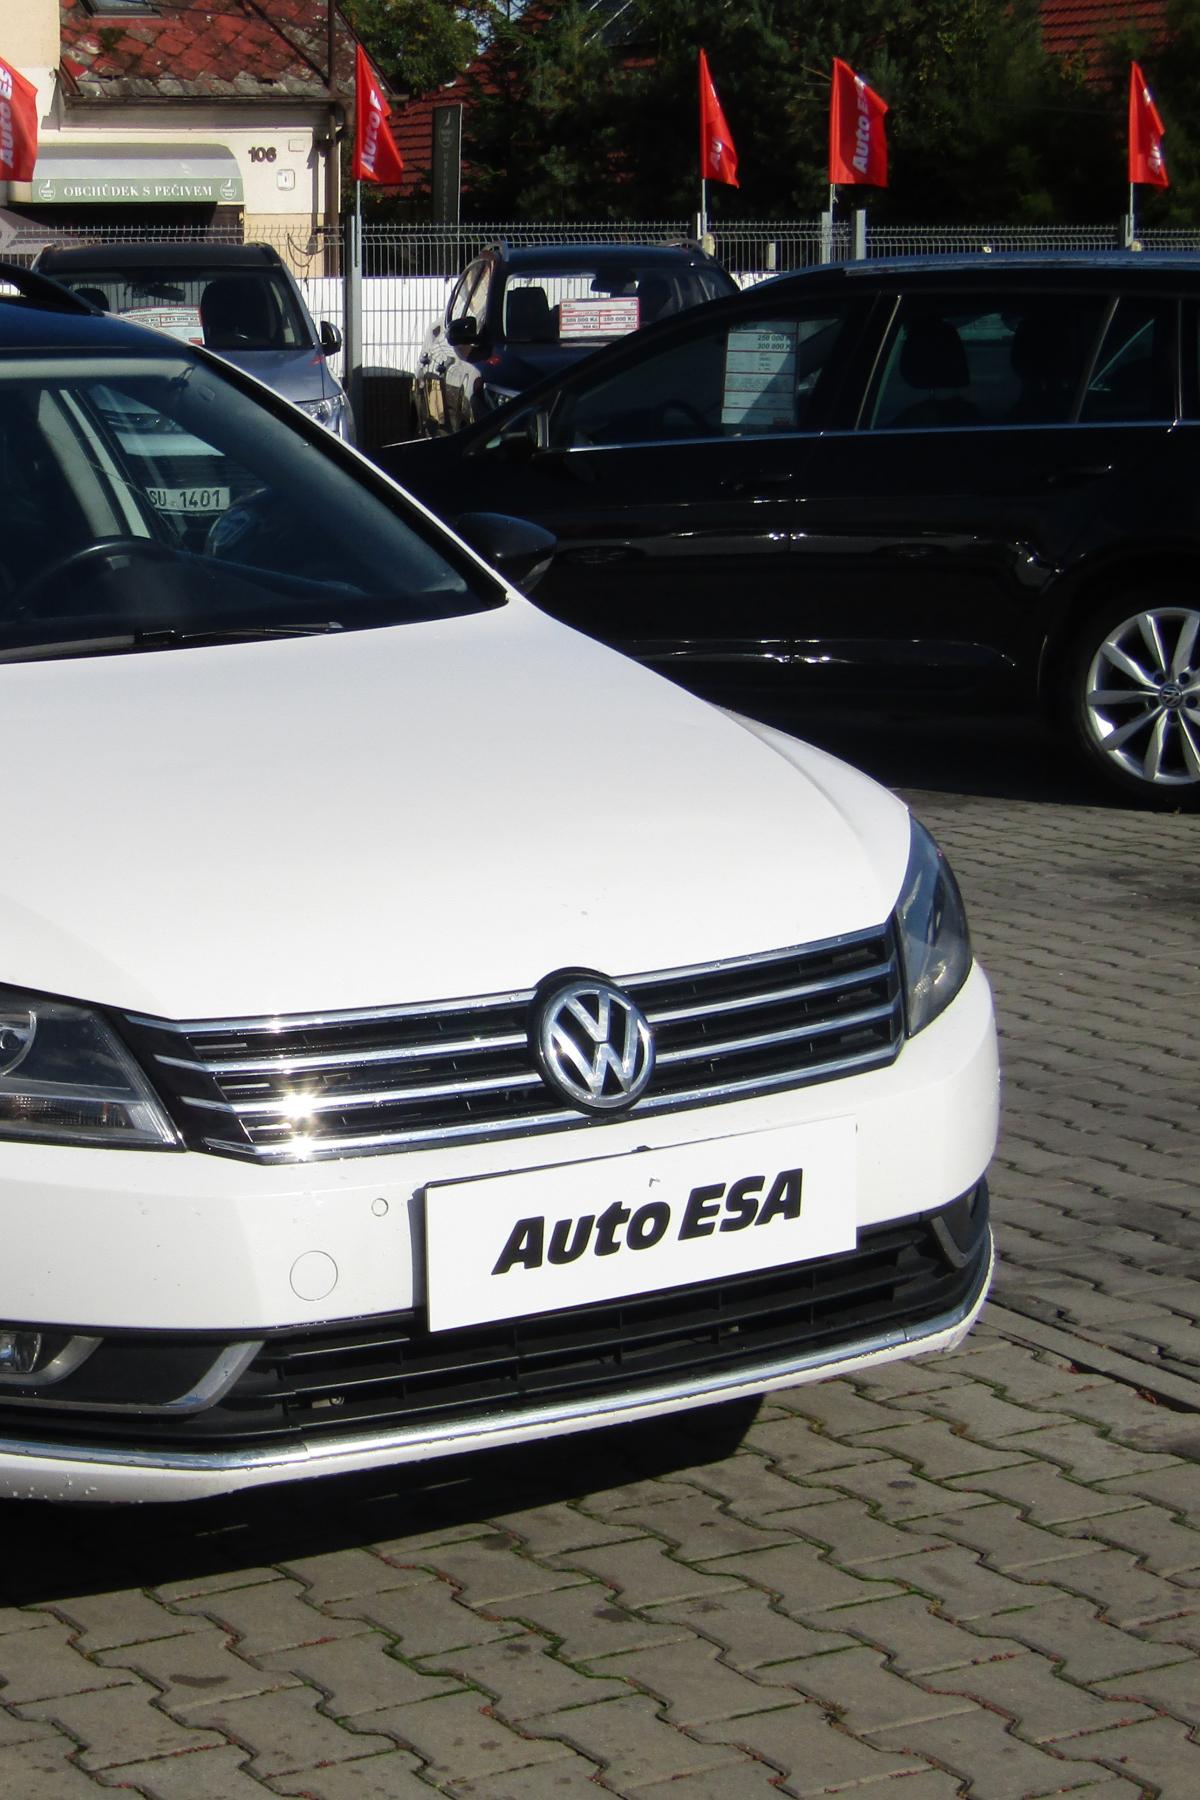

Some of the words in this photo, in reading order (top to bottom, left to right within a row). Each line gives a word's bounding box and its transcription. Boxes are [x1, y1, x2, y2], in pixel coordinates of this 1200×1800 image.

[0, 101, 14, 169] Auto
[248, 147, 277, 162] 106
[852, 115, 870, 175] Auto
[63, 183, 139, 198] OBCHŮDEK
[142, 184, 151, 198] S
[155, 182, 212, 198] PEČIVEM
[179, 489, 221, 509] 1401
[491, 1200, 671, 1276] Auto
[678, 1167, 803, 1241] ESA
